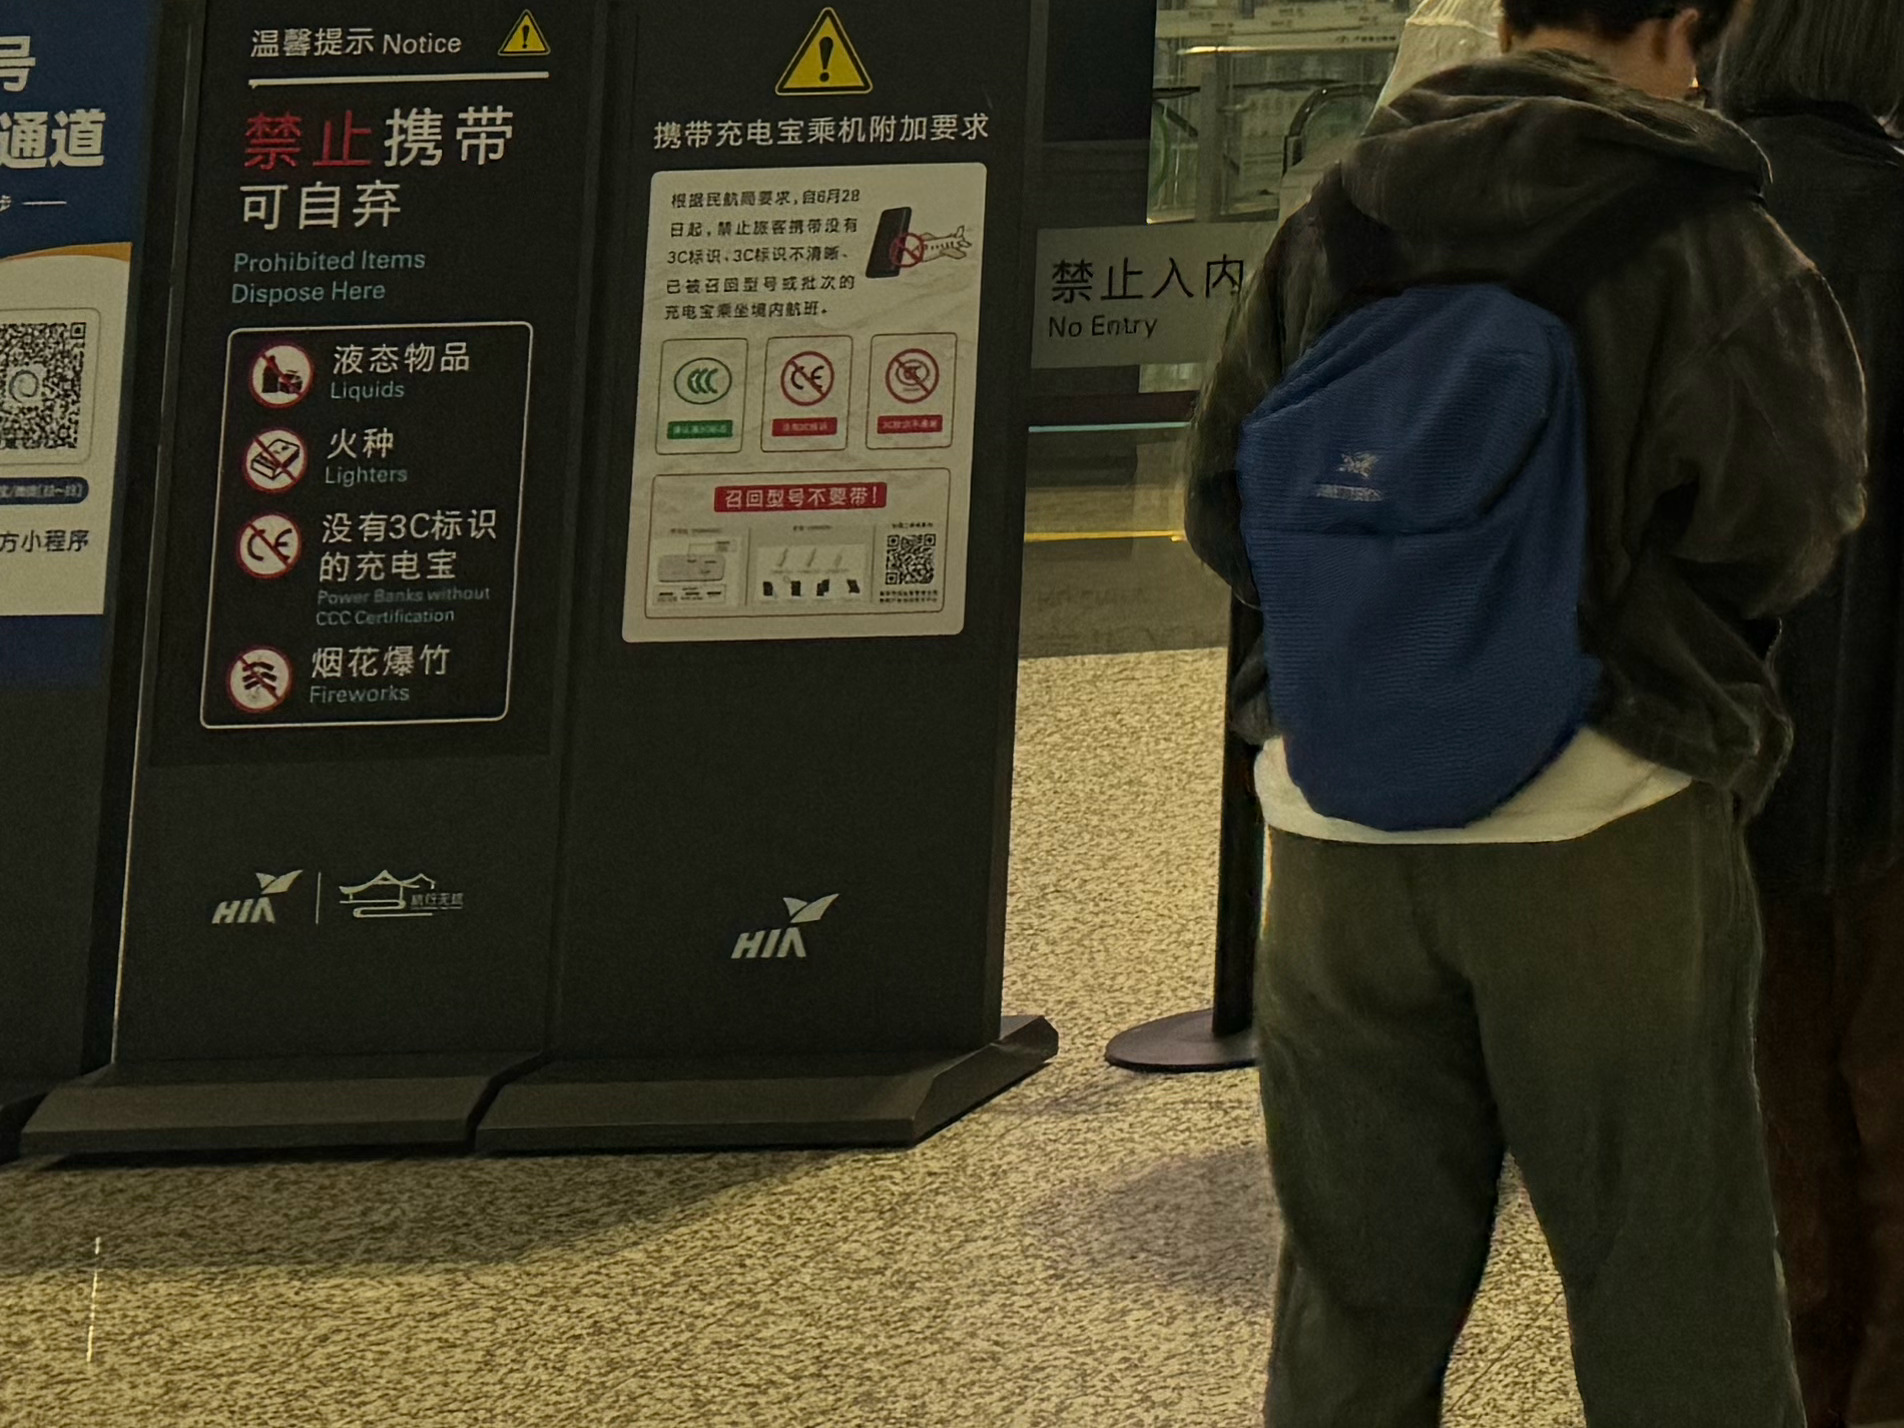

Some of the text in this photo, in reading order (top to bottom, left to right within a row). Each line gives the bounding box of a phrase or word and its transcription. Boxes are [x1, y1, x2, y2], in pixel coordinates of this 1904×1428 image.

[250, 27, 462, 58] 温馨提示 Notice
[244, 104, 515, 171] 禁止携带
[653, 113, 990, 150] 携带充电宝乘机附加要求
[240, 180, 402, 230] 可自弃
[233, 249, 426, 273] Prohibited Items
[231, 280, 386, 308] Dispose Here
[1052, 253, 1244, 304] 禁止入内
[1049, 315, 1158, 339] No Entry
[333, 341, 470, 375] 液态物品
[330, 380, 405, 403] Liquids
[326, 429, 394, 460] 火种
[325, 464, 408, 488] Lighters
[322, 509, 497, 544] 没有3C标识
[319, 550, 457, 583] 的充电宝
[317, 585, 490, 605] Power Banks without
[316, 607, 455, 626] CCC Certification
[311, 644, 450, 678] 烟花爆竹
[309, 685, 410, 704] Fireworks
